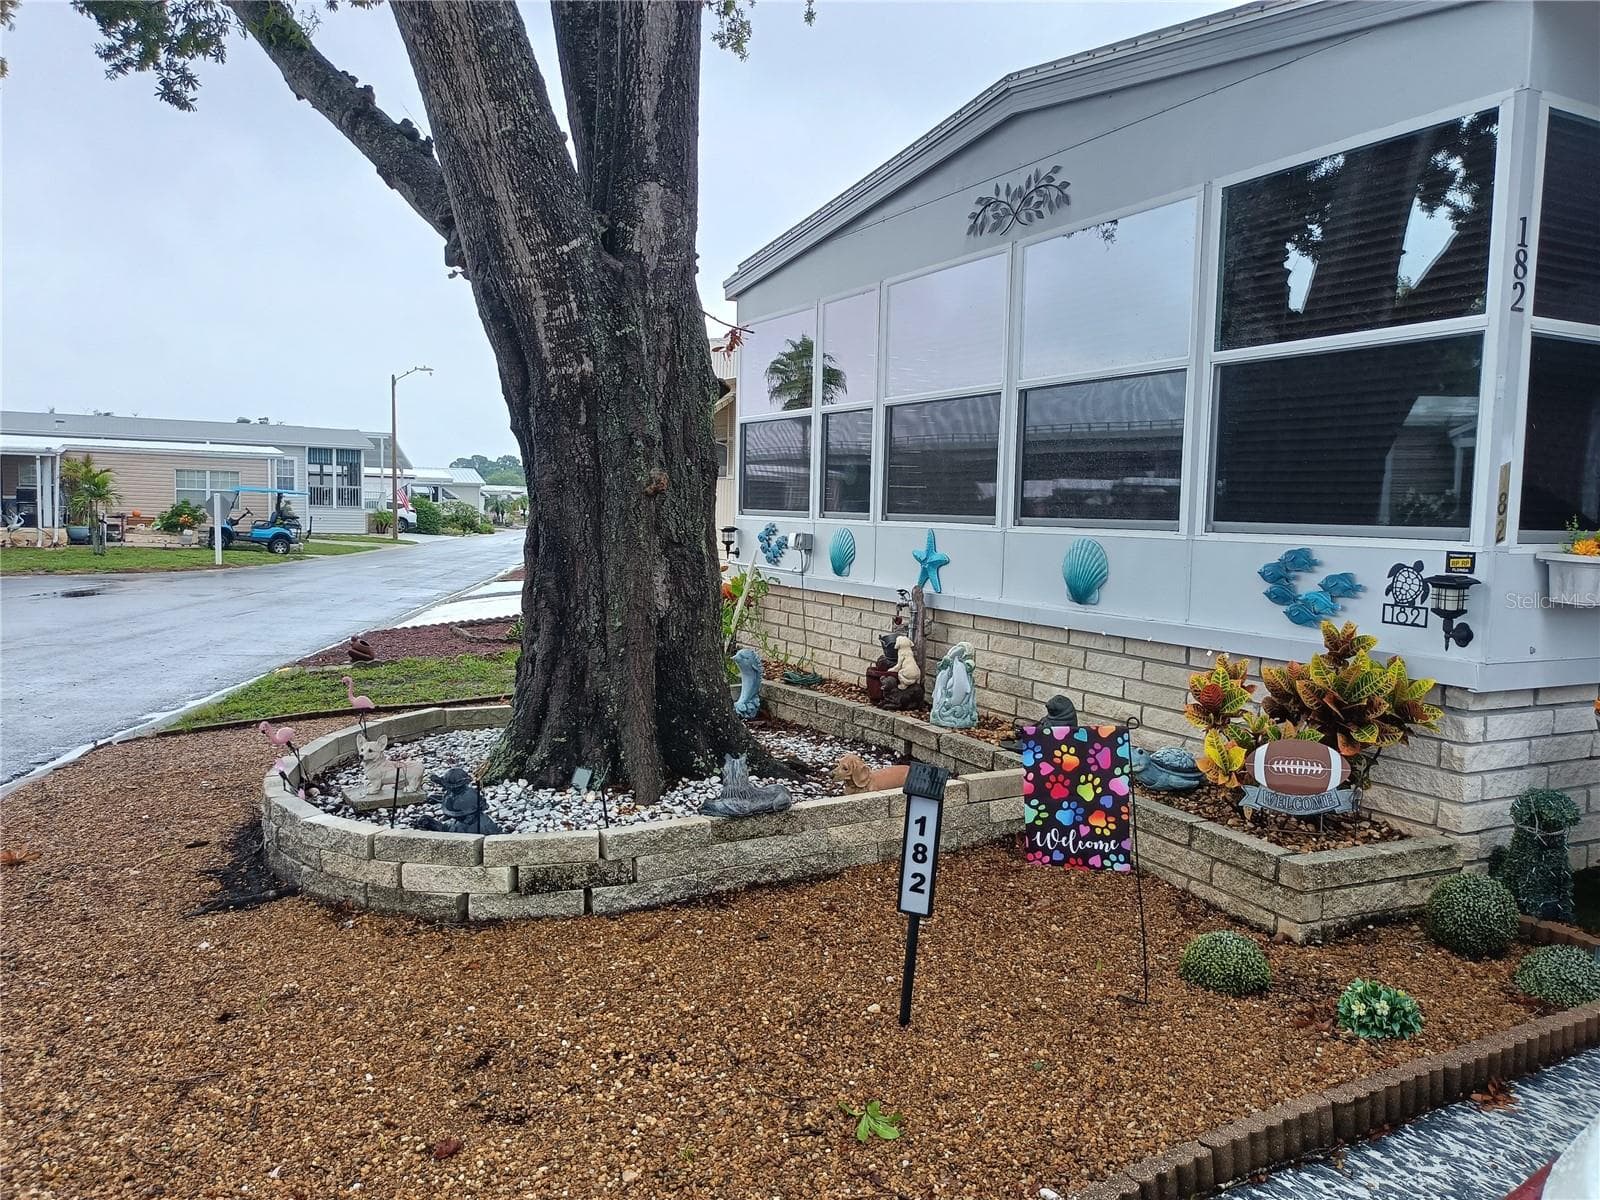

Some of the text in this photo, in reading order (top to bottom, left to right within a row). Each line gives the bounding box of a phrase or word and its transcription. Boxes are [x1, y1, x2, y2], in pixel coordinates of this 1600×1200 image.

[1510, 216, 1528, 312] 182
[1390, 606, 1420, 625] 182
[1262, 788, 1337, 812] WELCOME
[1032, 828, 1120, 854] Welcome
[909, 815, 928, 894] 182
